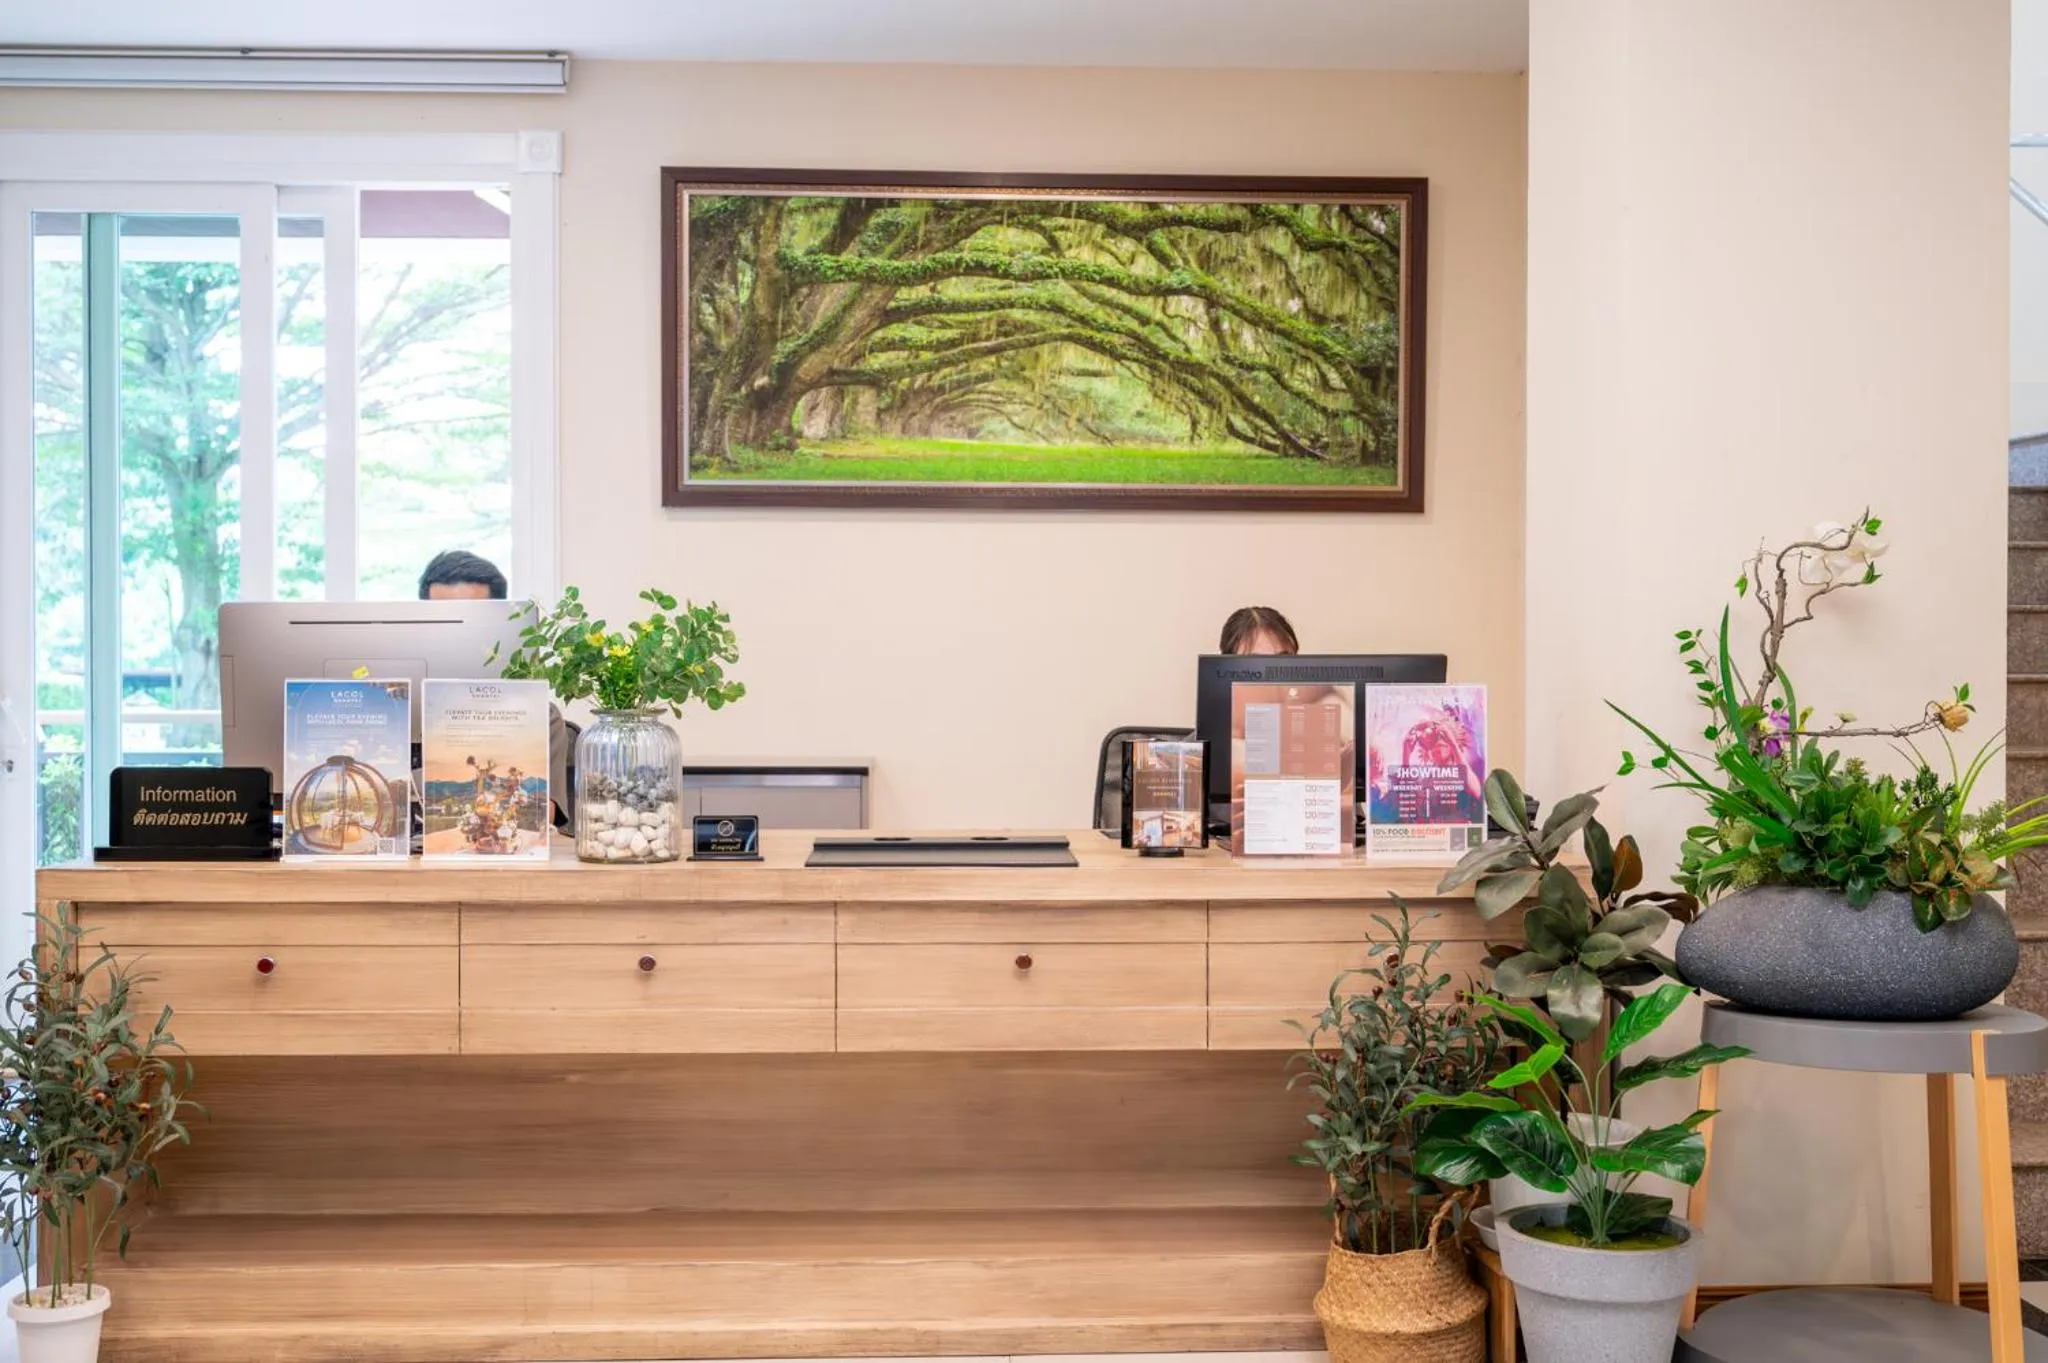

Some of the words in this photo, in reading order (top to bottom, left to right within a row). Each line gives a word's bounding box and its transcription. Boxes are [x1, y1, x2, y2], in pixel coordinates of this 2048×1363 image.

[1396, 767, 1460, 778] SHOWTIME
[140, 786, 237, 802] Information
[132, 808, 248, 826] ติดต่อสอบถาม
